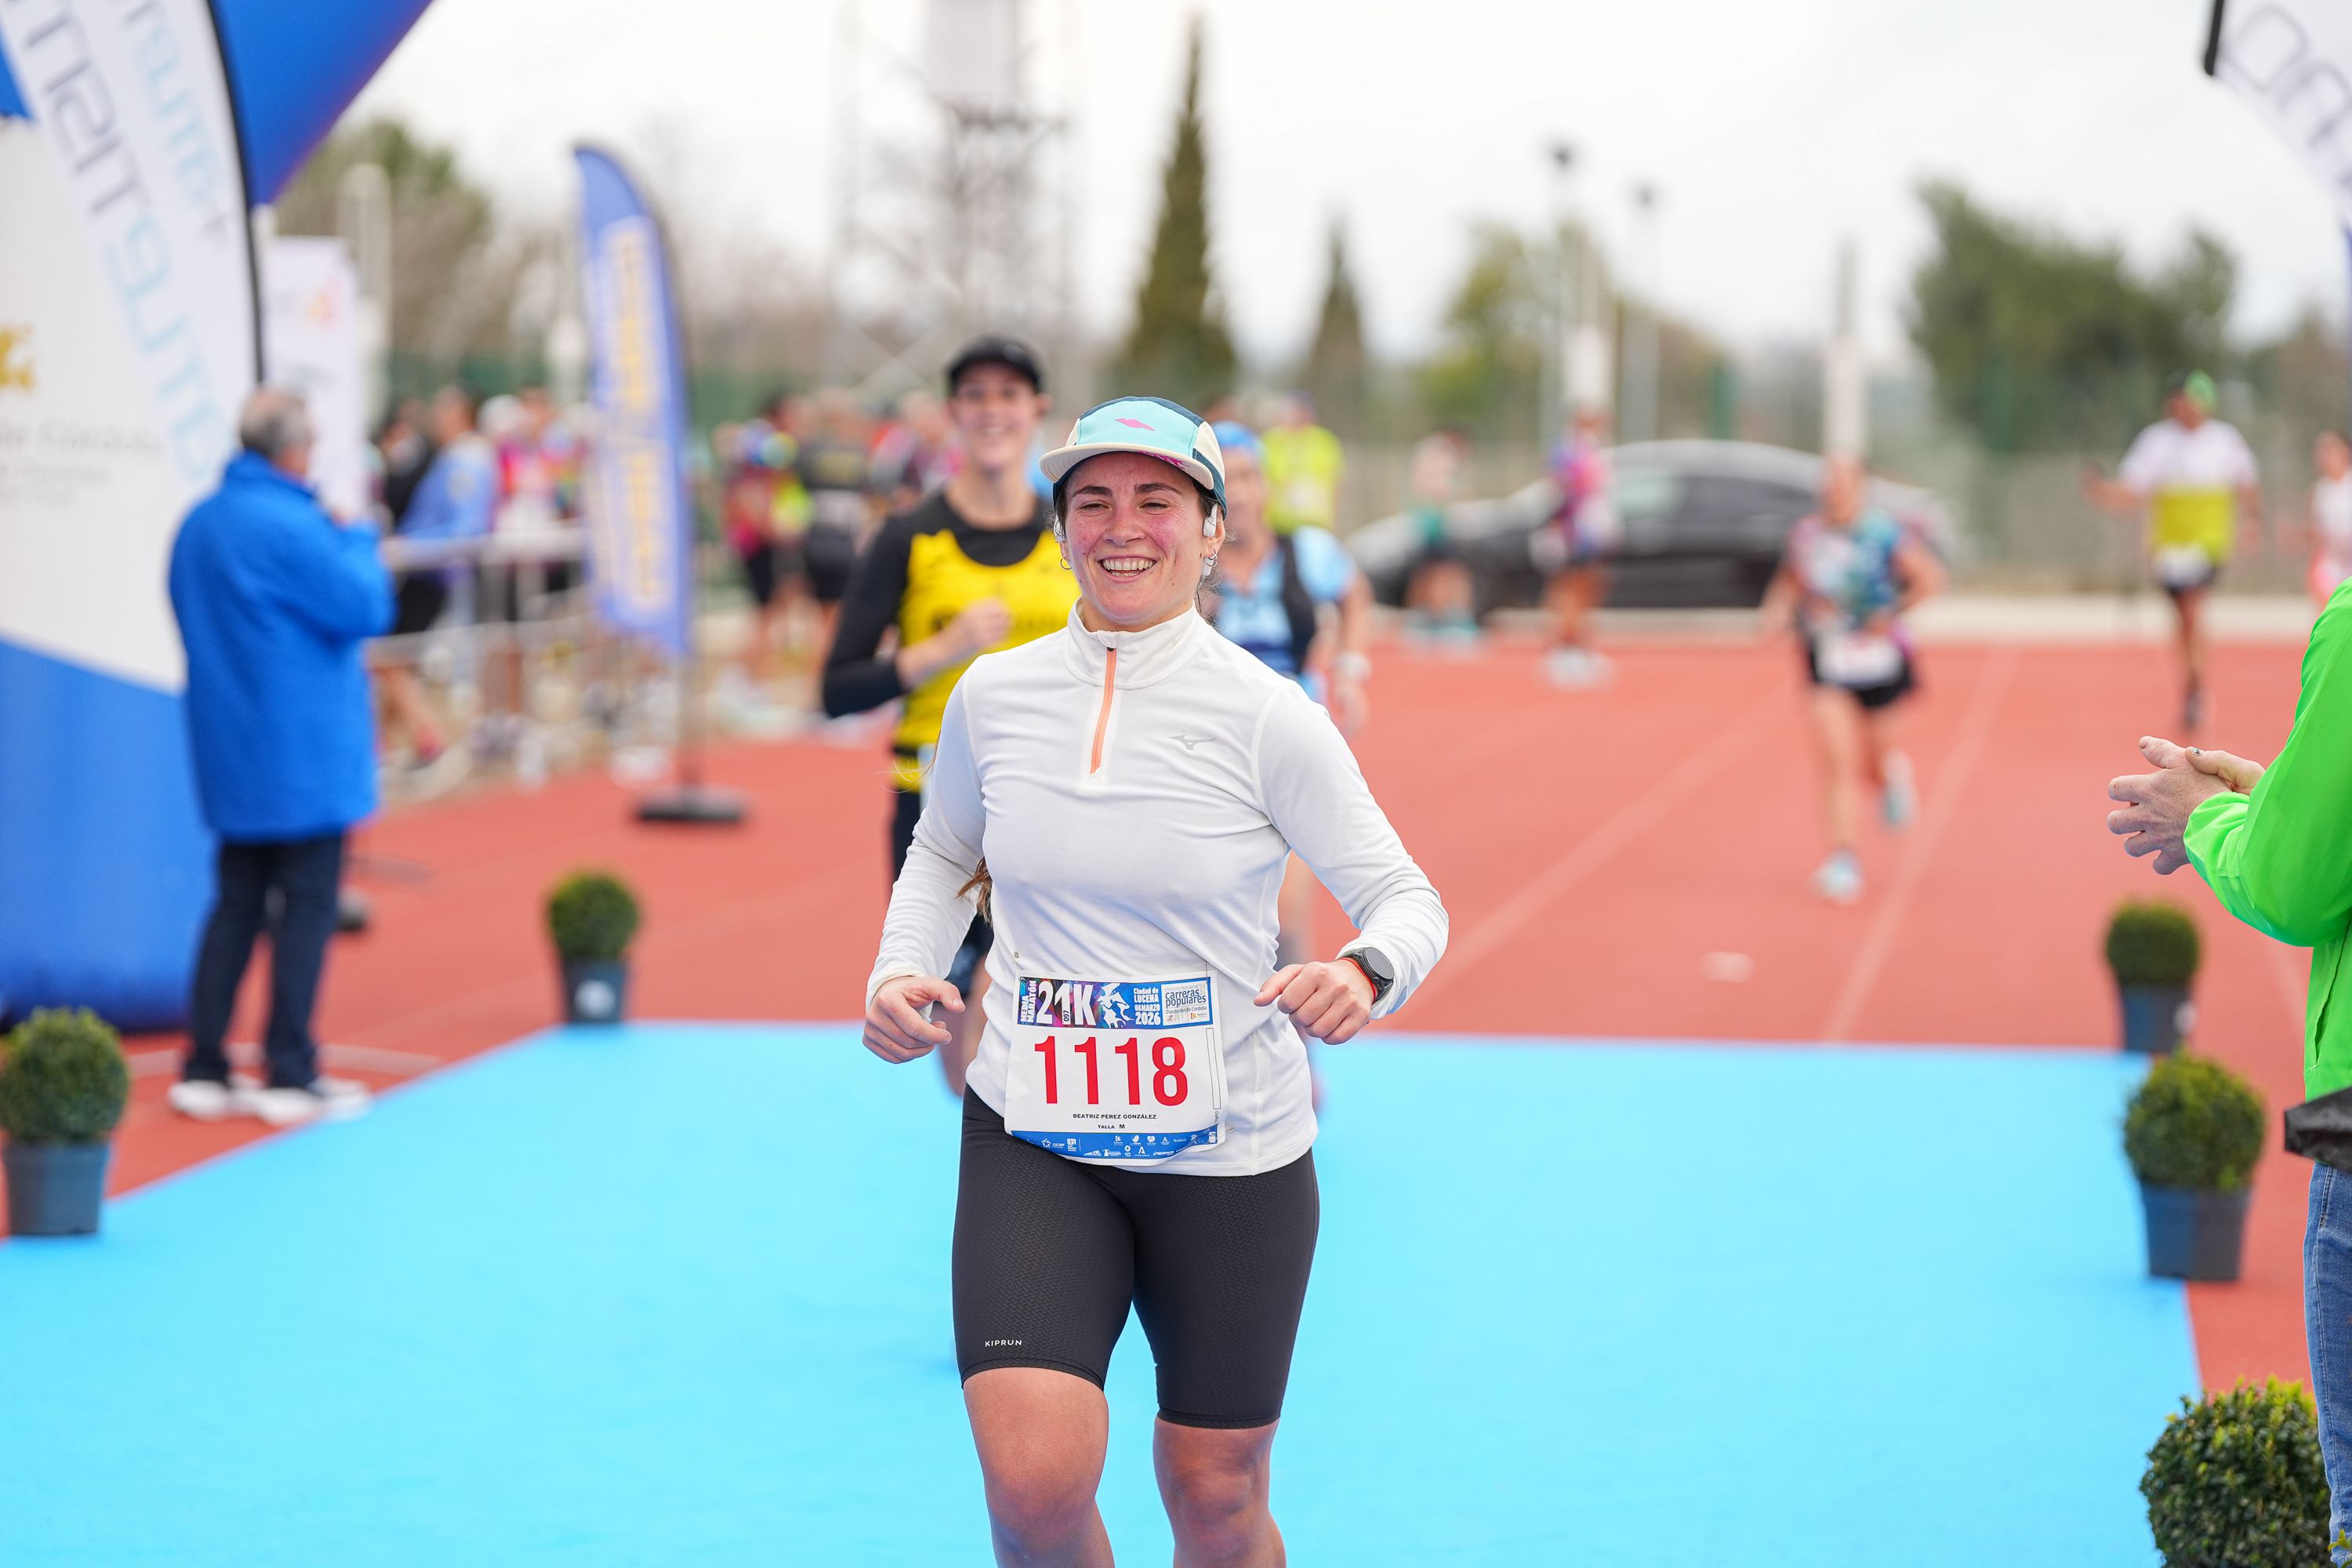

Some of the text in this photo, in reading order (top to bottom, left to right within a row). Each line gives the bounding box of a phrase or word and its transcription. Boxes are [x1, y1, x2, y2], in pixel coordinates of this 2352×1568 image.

[1027, 980, 1037, 1022] MARATÓN
[1134, 994, 1160, 1003] LUCENA
[1165, 989, 1200, 1000] carreras
[1036, 981, 1096, 1025] 21K
[1166, 995, 1206, 1008] populares
[1135, 1011, 1161, 1025] 2026
[1034, 1035, 1189, 1107] 1118
[985, 1339, 1022, 1348] KIPRUN
